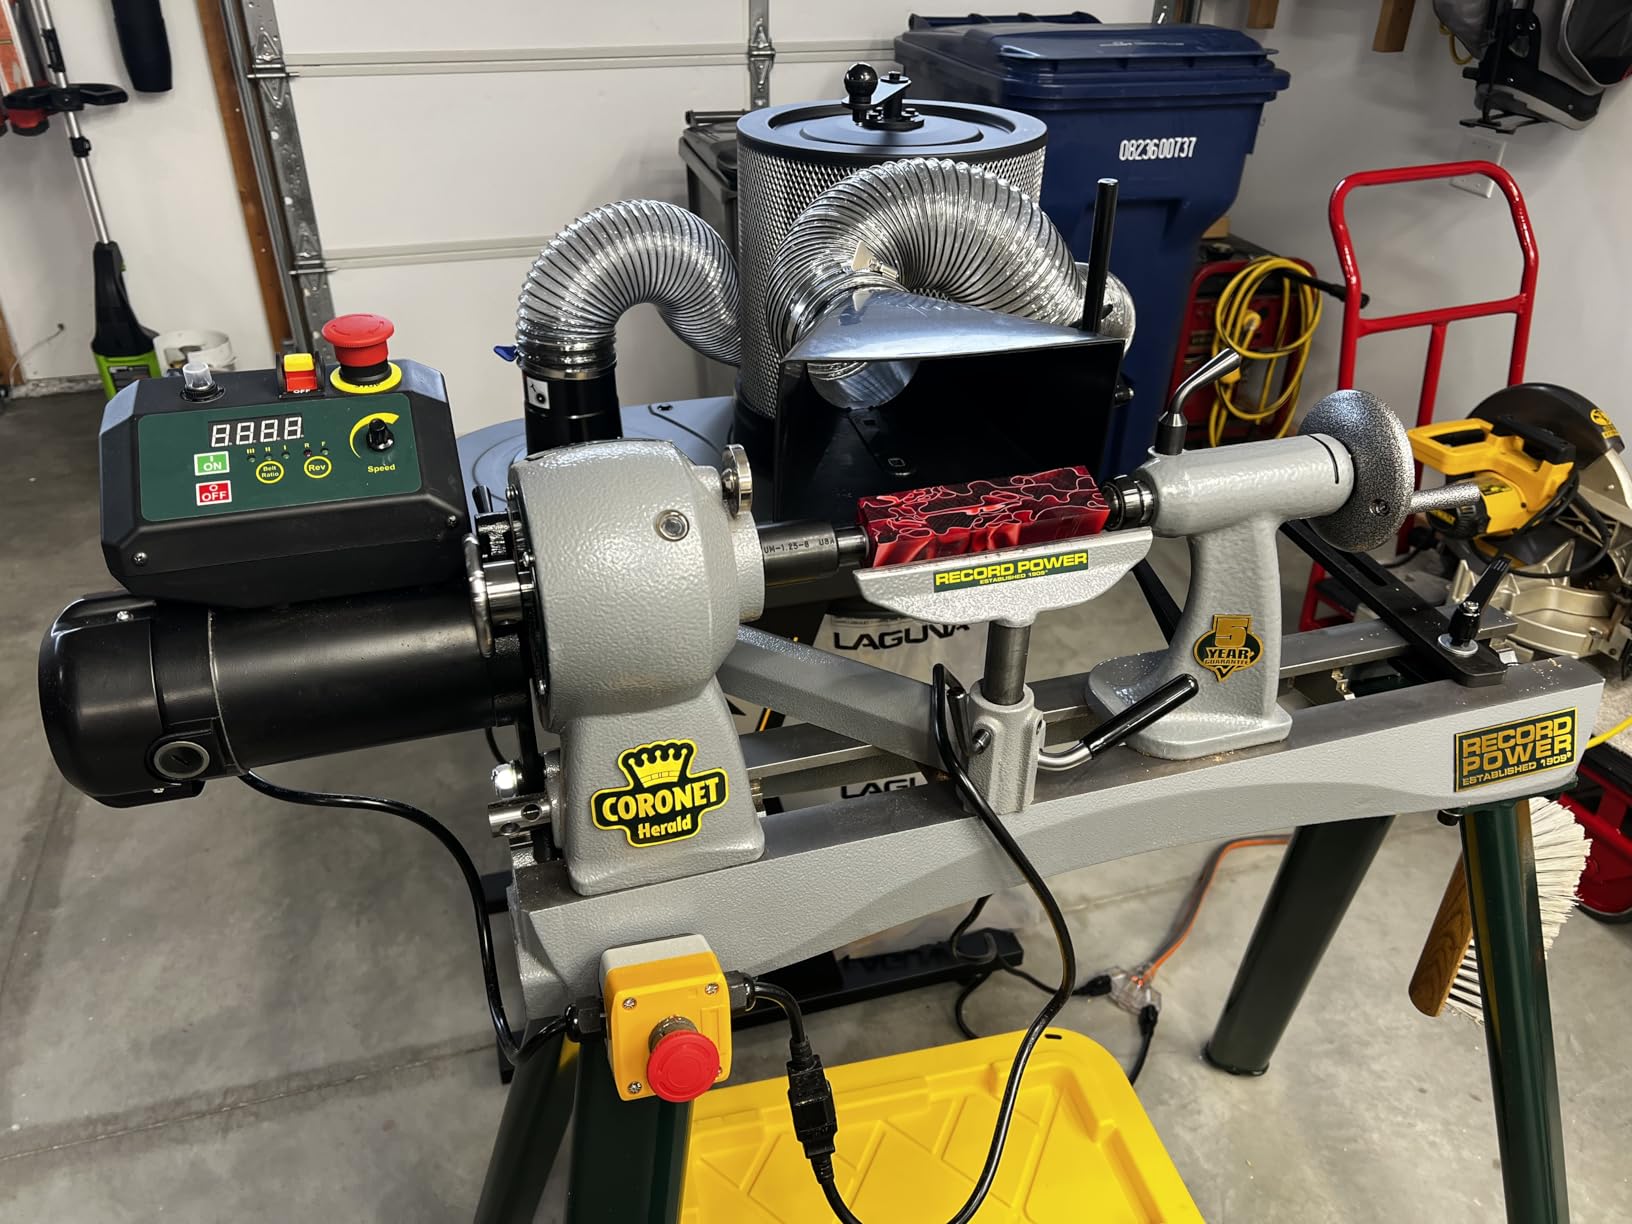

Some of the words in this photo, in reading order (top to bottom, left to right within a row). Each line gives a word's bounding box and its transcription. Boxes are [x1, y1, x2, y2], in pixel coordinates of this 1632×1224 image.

[1119, 137, 1197, 160] 0823600737
[203, 462, 222, 471] ON
[308, 464, 326, 472] Rev
[367, 464, 396, 474] Speed
[201, 491, 227, 501] OFF
[935, 563, 1014, 586] RECORD
[1017, 552, 1088, 574] POWER
[980, 573, 1026, 585] ESTABLISHED
[1215, 617, 1250, 647] 5
[1206, 648, 1250, 659] YEAR
[1463, 716, 1572, 757] RECORD
[1463, 735, 1572, 776] POWER
[1463, 761, 1537, 786] ESTABLISHED
[602, 777, 719, 821] CORONET
[637, 814, 692, 839] Herald
